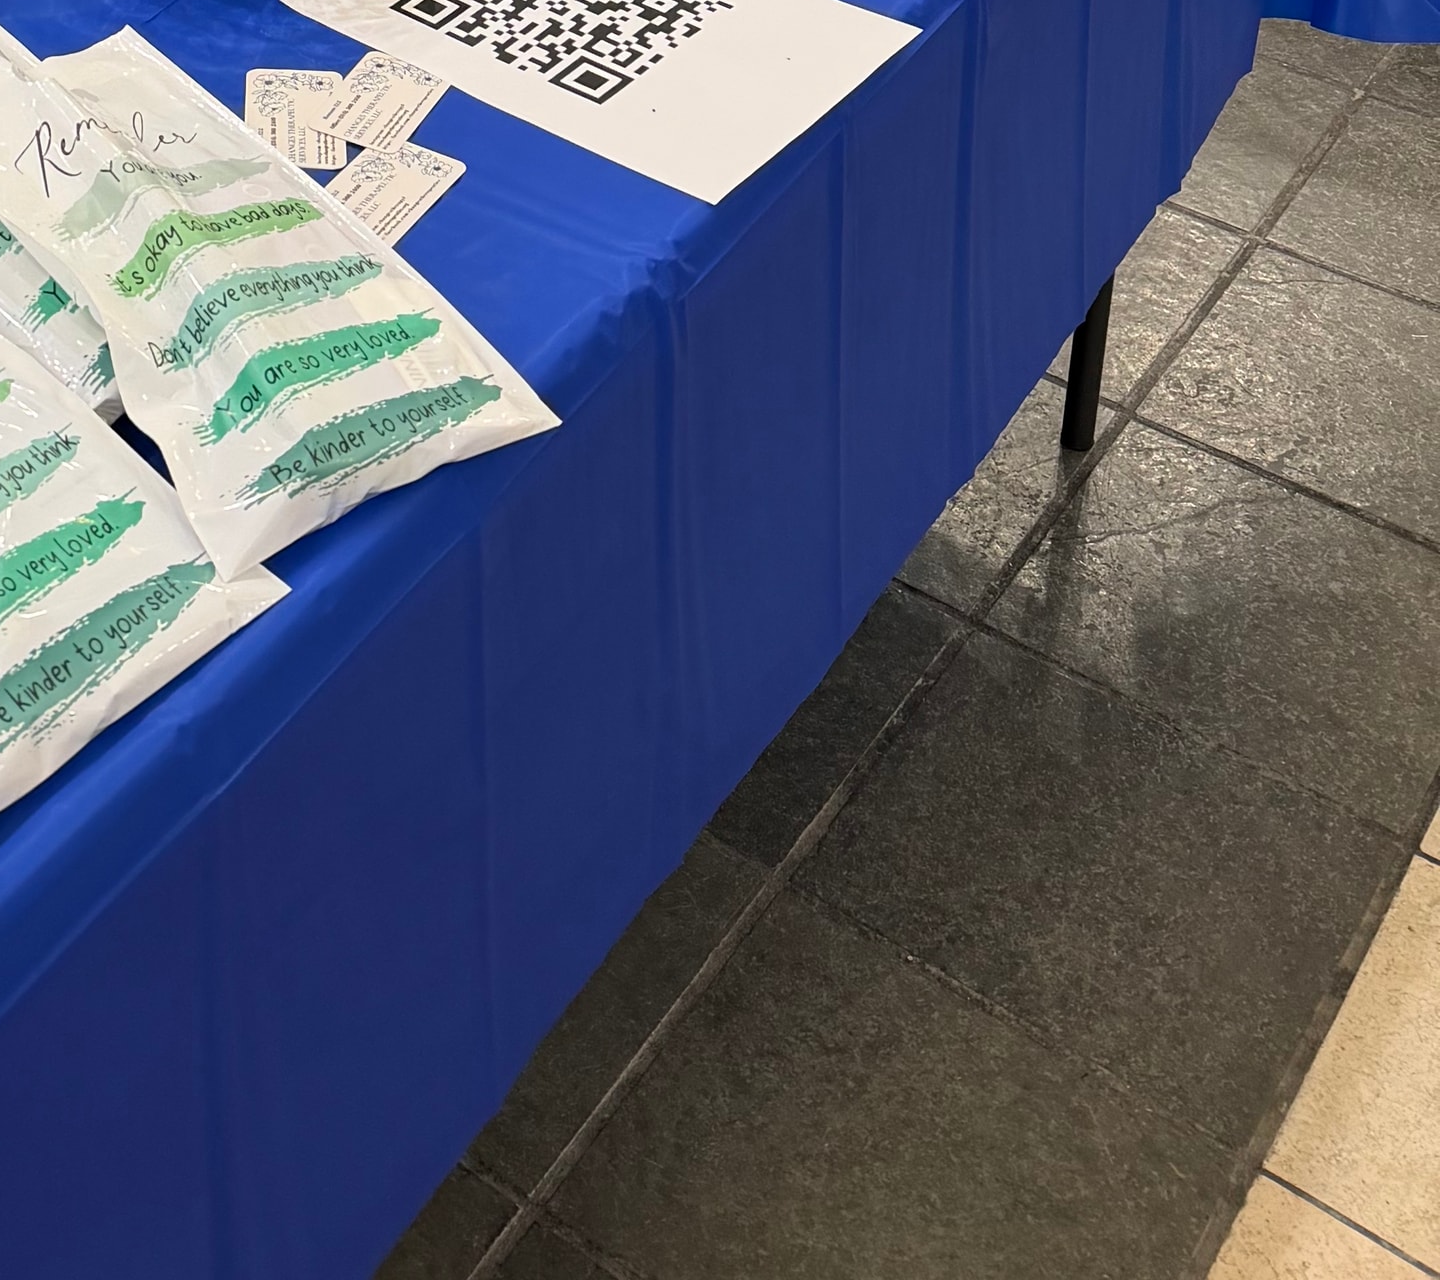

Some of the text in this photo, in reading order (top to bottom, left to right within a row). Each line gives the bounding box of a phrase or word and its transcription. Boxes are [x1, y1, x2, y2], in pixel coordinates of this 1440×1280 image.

[243, 201, 310, 224] bad days.
[320, 323, 415, 363] very loved.
[269, 386, 476, 484] Be kinder to yourself.
[1, 460, 37, 491] you
[16, 552, 62, 583] very
[55, 515, 120, 555] loved.
[9, 658, 73, 708] kinder
[72, 635, 104, 663] to
[104, 576, 190, 649] yourself.
